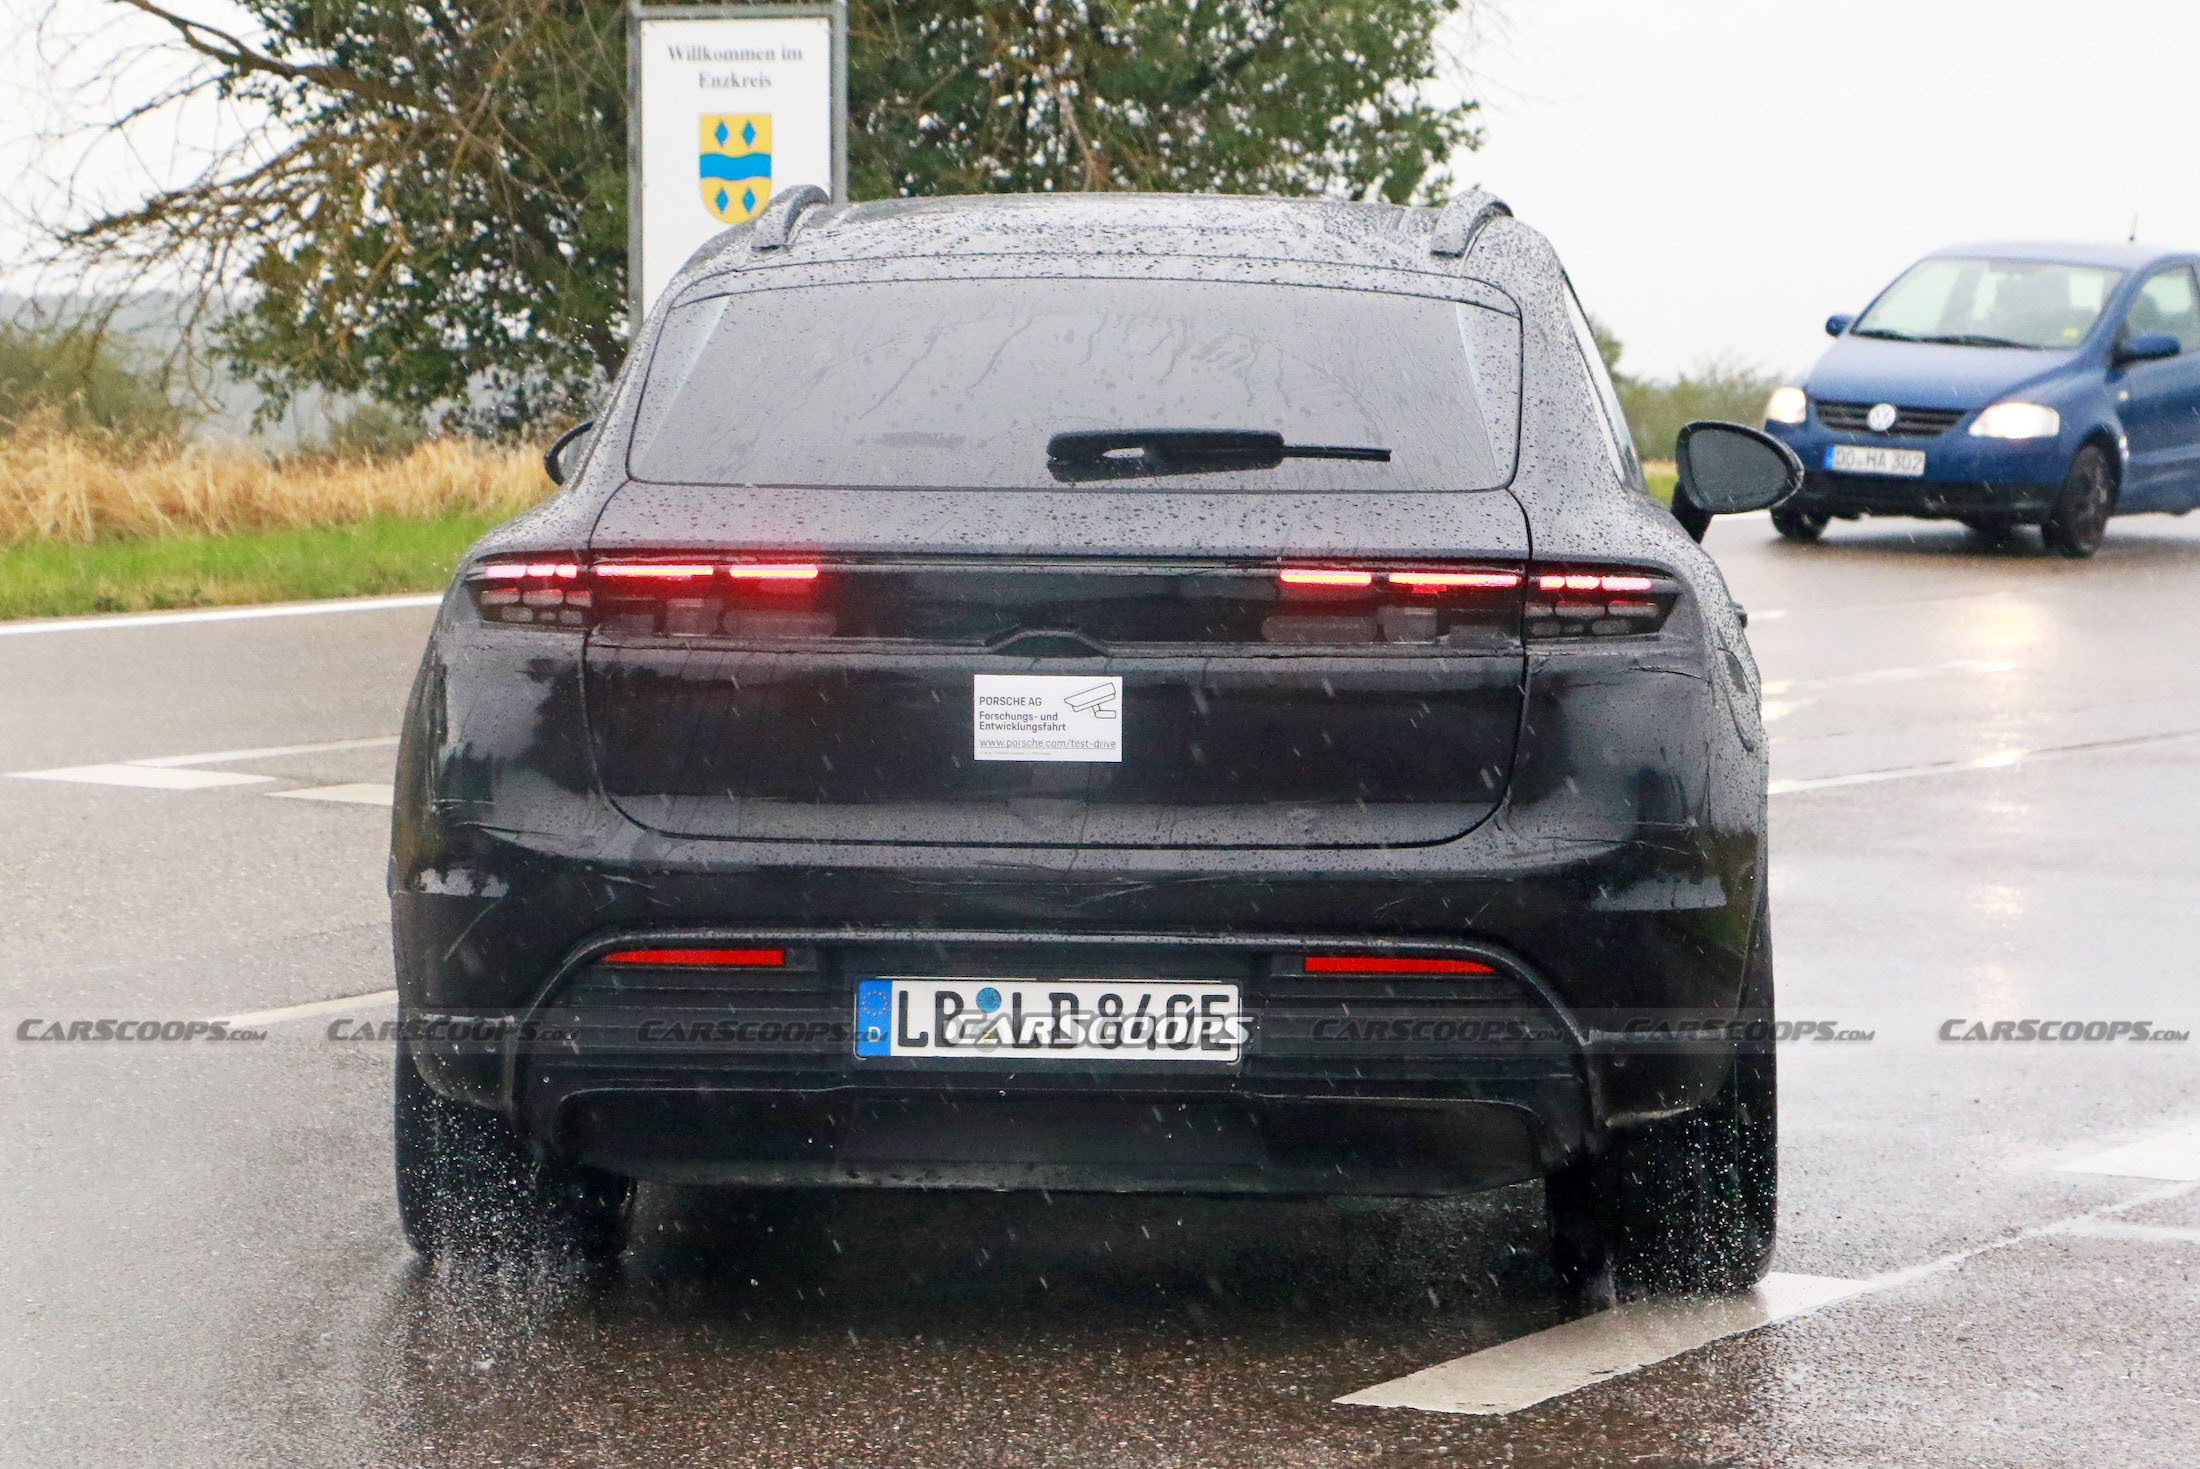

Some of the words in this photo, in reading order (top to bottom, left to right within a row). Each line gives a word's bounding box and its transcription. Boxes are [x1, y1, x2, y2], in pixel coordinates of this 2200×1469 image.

[667, 45, 776, 62] Willkommen
[781, 45, 803, 61] im
[698, 72, 772, 89] Enzkreis
[979, 696, 1026, 707] PORSCHE
[1028, 697, 1042, 707] AG
[979, 711, 1038, 723] Forschungs-
[1040, 712, 1058, 722] und
[979, 721, 1067, 733] Entwicklungsfahrt
[980, 738, 1117, 749] www.porsche.com/test-drive
[868, 1026, 881, 1043] D
